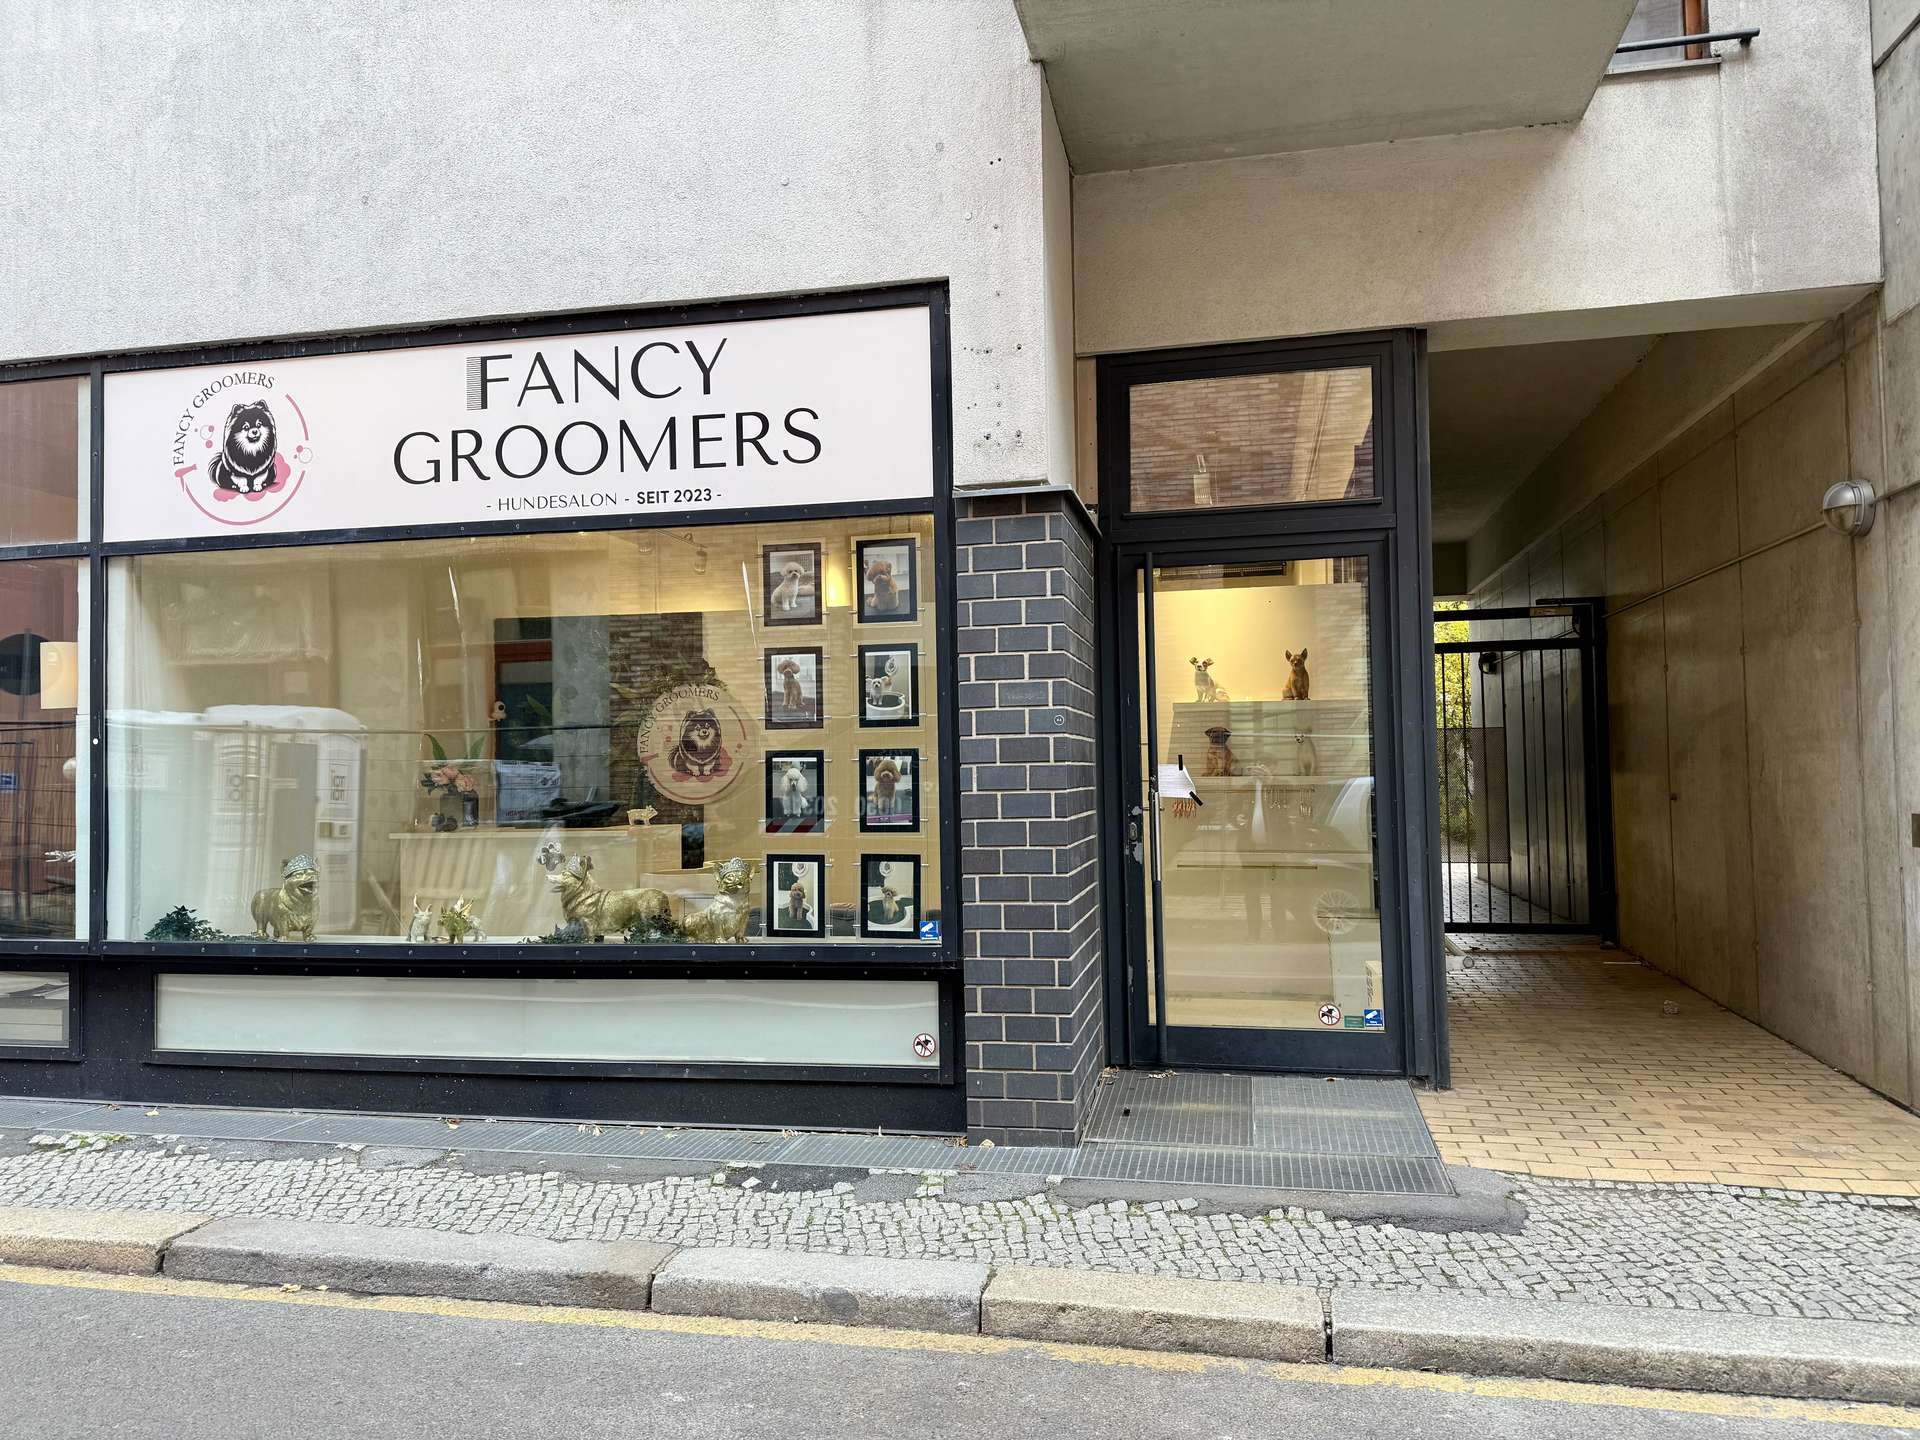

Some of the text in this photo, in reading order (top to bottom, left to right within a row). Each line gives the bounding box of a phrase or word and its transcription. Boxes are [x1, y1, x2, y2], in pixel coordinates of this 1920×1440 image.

[467, 337, 728, 411] FANCY
[173, 371, 275, 466] FANCY GROOMERS
[393, 407, 822, 485] GROOMERS
[498, 492, 618, 512] HUNDESALON
[636, 490, 670, 505] SEIT
[673, 487, 712, 503] 2023
